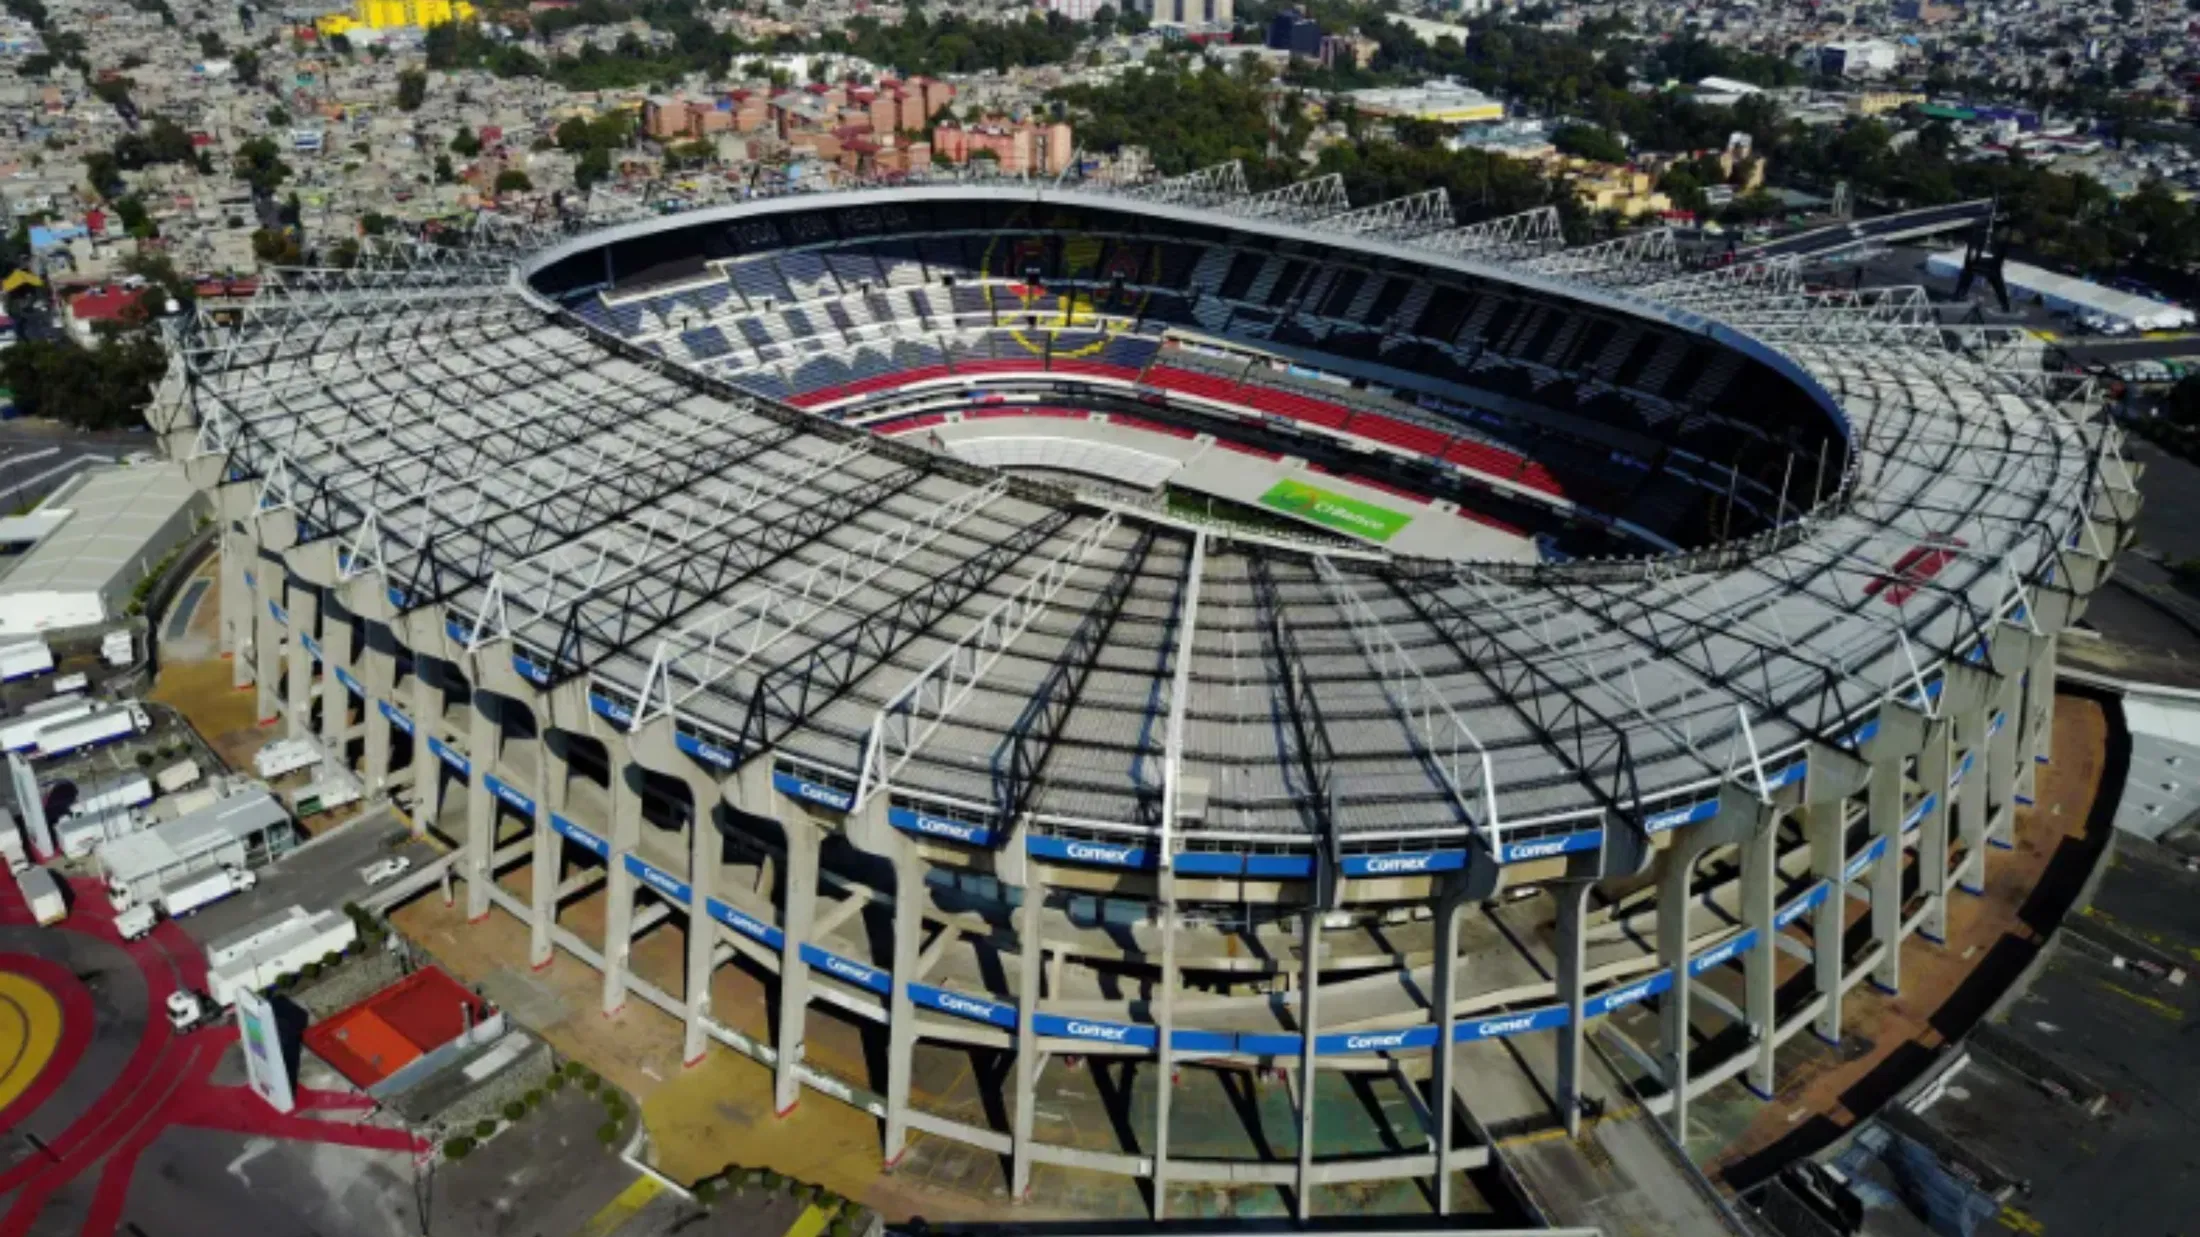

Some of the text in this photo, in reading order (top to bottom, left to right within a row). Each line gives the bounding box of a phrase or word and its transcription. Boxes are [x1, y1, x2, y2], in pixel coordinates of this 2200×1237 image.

[800, 783, 850, 810] Comex
[917, 816, 973, 840] Comex
[1645, 808, 1695, 832] Comex
[1066, 843, 1130, 862] Comex
[1511, 837, 1570, 859] Comex
[1367, 855, 1431, 873] Comex
[727, 910, 767, 935] Comex
[827, 957, 872, 982] Comex
[939, 993, 994, 1018] Comex
[1605, 981, 1651, 1009] Comex
[1067, 1022, 1128, 1039] Comex
[1479, 1012, 1536, 1035] Comex
[1348, 1031, 1408, 1049] Comex
